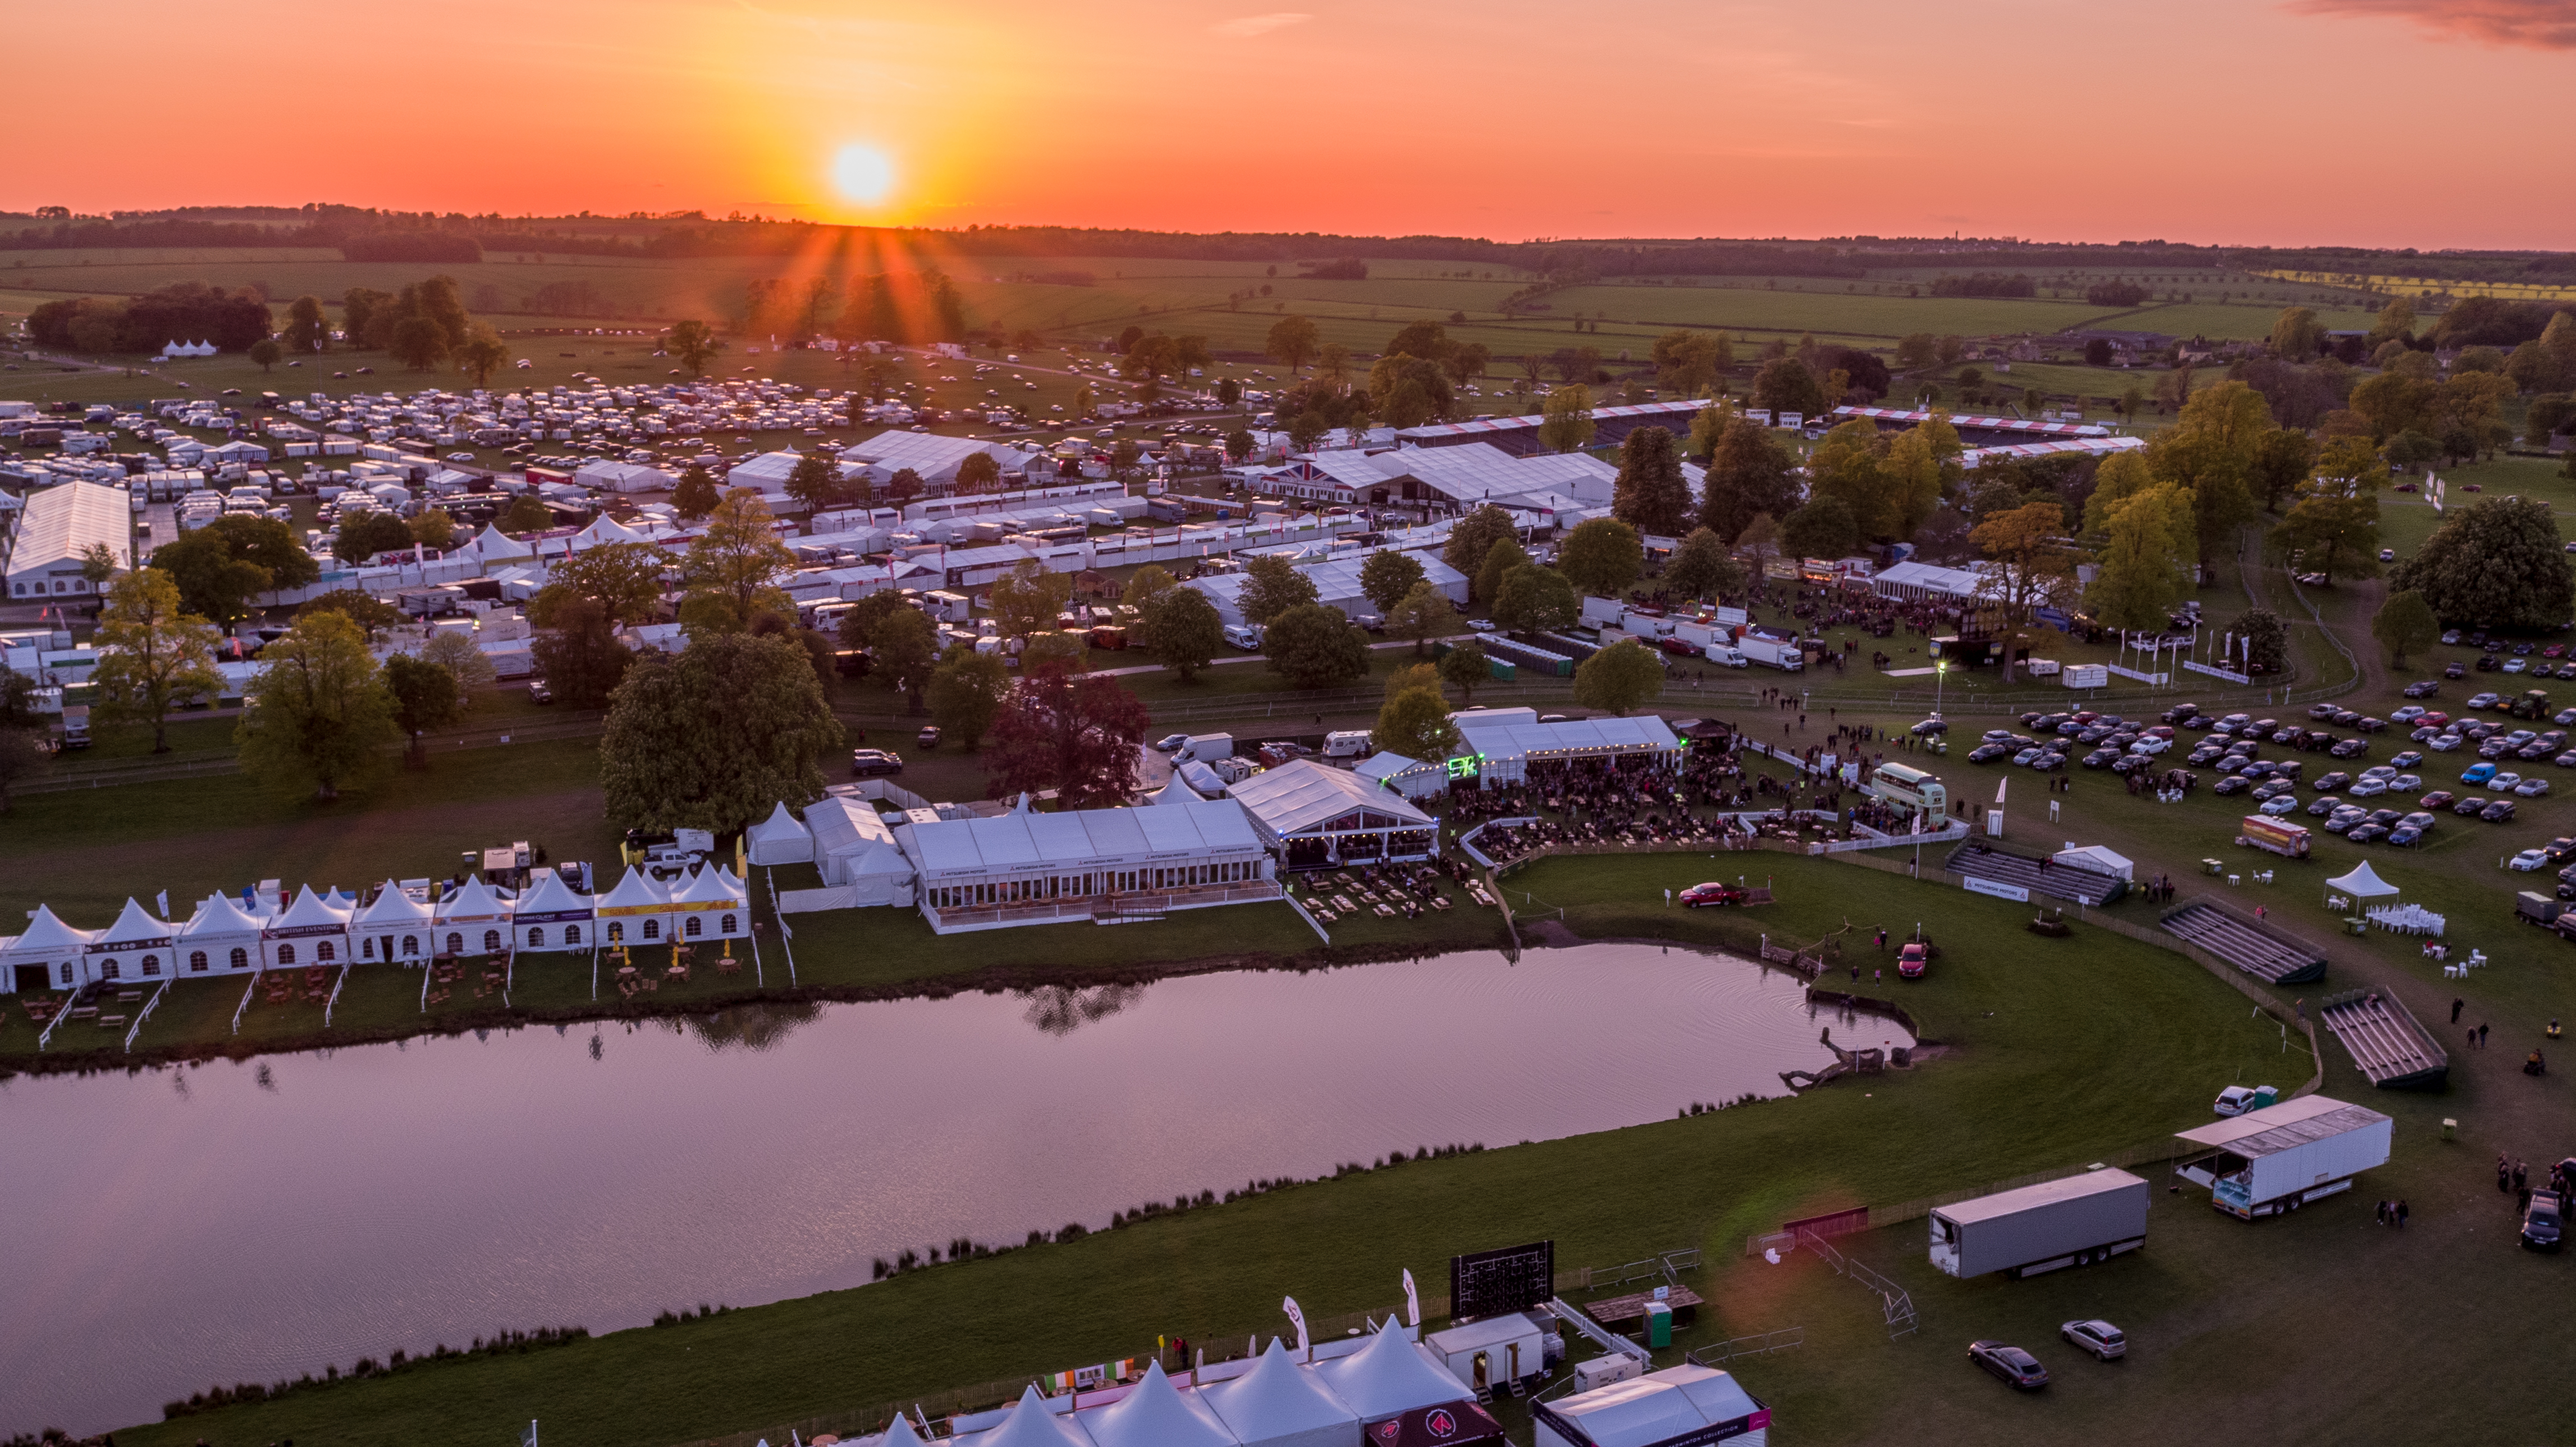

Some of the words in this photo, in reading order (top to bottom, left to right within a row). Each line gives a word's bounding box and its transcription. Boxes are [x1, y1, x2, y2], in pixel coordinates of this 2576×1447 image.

[1974, 883, 1998, 891] MITSUBISHI
[609, 906, 636, 915] savills
[659, 904, 685, 912] savills
[1703, 1426, 1738, 1439] COLLECTION
